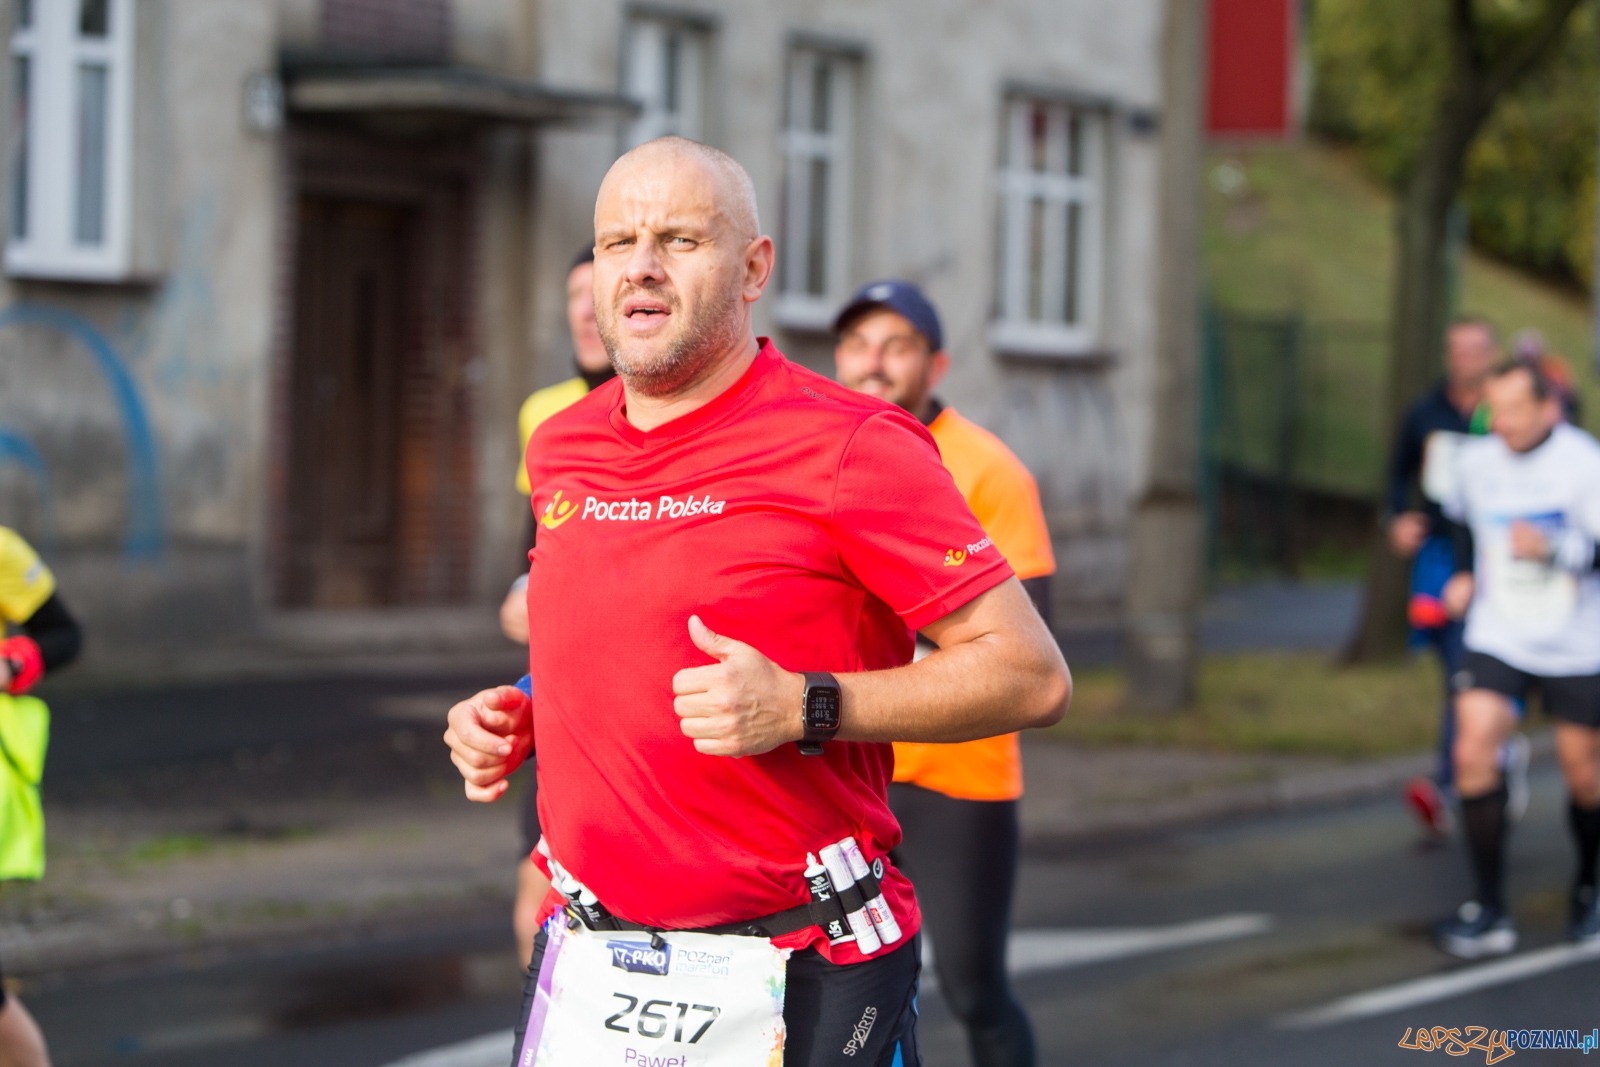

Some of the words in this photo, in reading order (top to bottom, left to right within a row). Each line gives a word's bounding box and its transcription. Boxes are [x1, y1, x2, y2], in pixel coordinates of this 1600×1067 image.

[581, 496, 651, 521] Poczta
[656, 495, 726, 520] Polska
[604, 992, 721, 1044] 2617
[625, 1047, 687, 1067] Paweł
